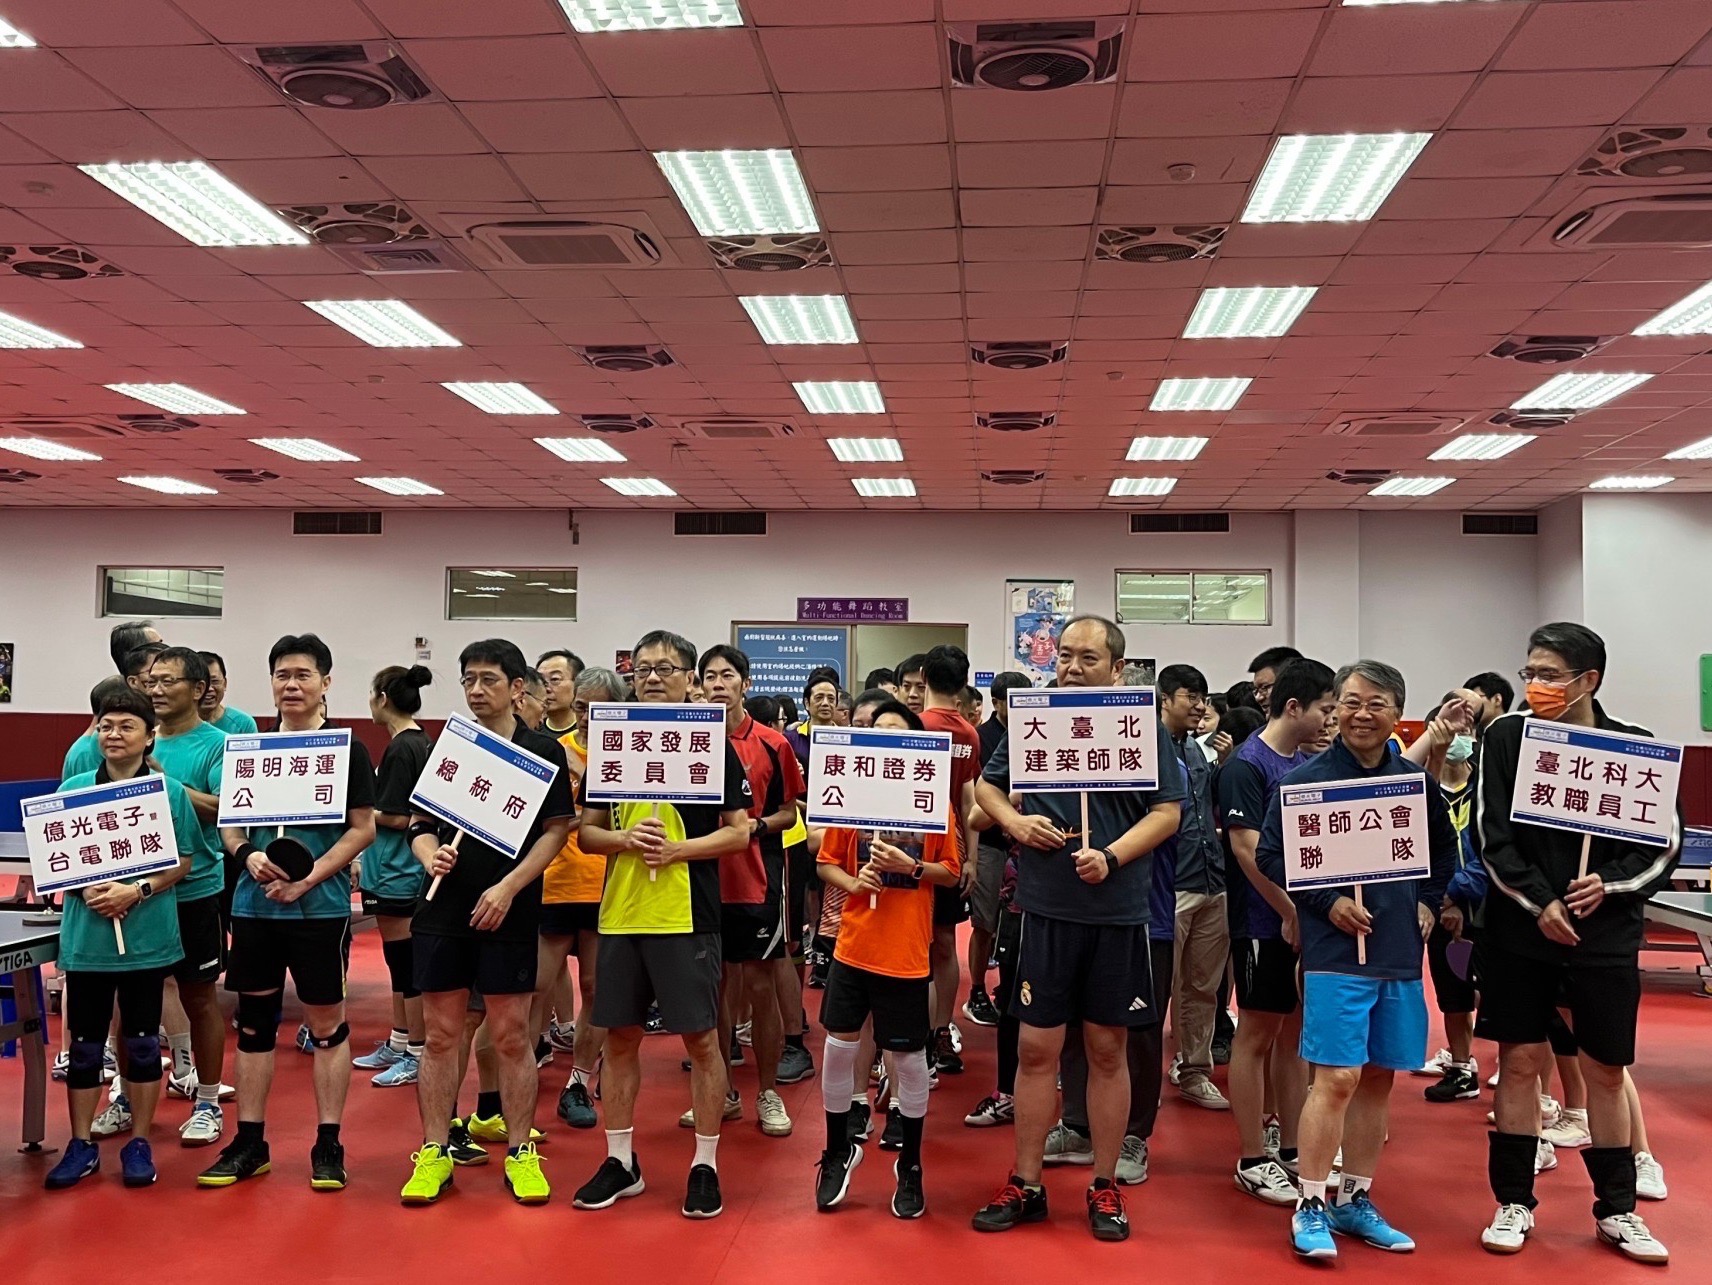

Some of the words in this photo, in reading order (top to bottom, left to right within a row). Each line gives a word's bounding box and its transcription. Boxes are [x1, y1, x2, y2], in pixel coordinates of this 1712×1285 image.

[803, 601, 903, 611] 多功能舞蹈教室
[1024, 715, 1141, 740] 大臺北
[602, 730, 711, 753] 國家發展
[235, 753, 336, 779] 陽明海運
[600, 760, 710, 785] 委員會
[823, 754, 936, 782] 康和證券
[1024, 747, 1142, 772] 建築師隊
[1534, 750, 1662, 793] 臺北科大
[232, 784, 333, 809] 公司
[435, 757, 527, 820] 總統府
[822, 785, 934, 813] 公司
[1530, 782, 1658, 825] 教職員工
[1298, 804, 1412, 838] 醫師公會
[47, 831, 163, 873] 台電聯隊
[1299, 836, 1415, 870] 聯隊
[0, 951, 33, 972] TIGA
